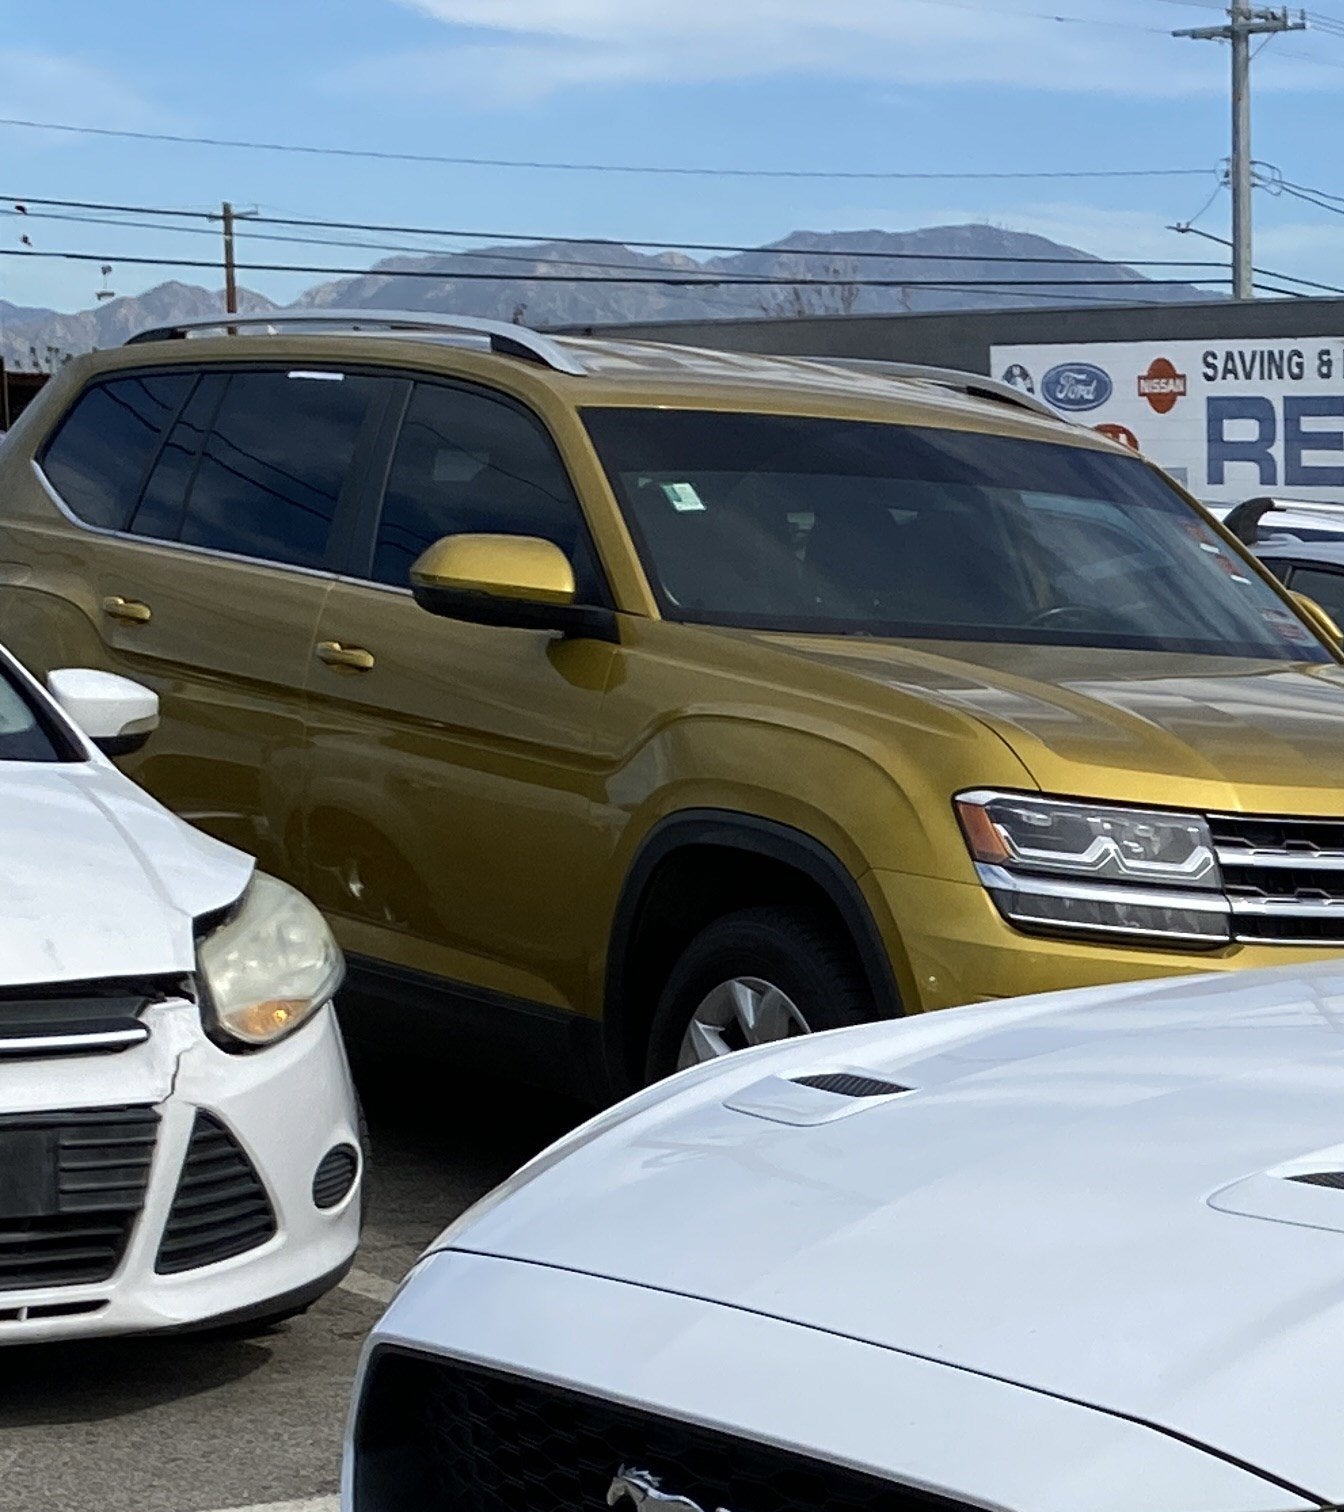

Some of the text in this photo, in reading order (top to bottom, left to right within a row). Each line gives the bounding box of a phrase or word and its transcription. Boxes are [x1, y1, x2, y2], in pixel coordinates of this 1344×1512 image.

[1202, 349, 1305, 382] SAVING
[1316, 348, 1333, 380] &
[1055, 371, 1099, 401] Ford
[1140, 377, 1185, 393] NISSAN
